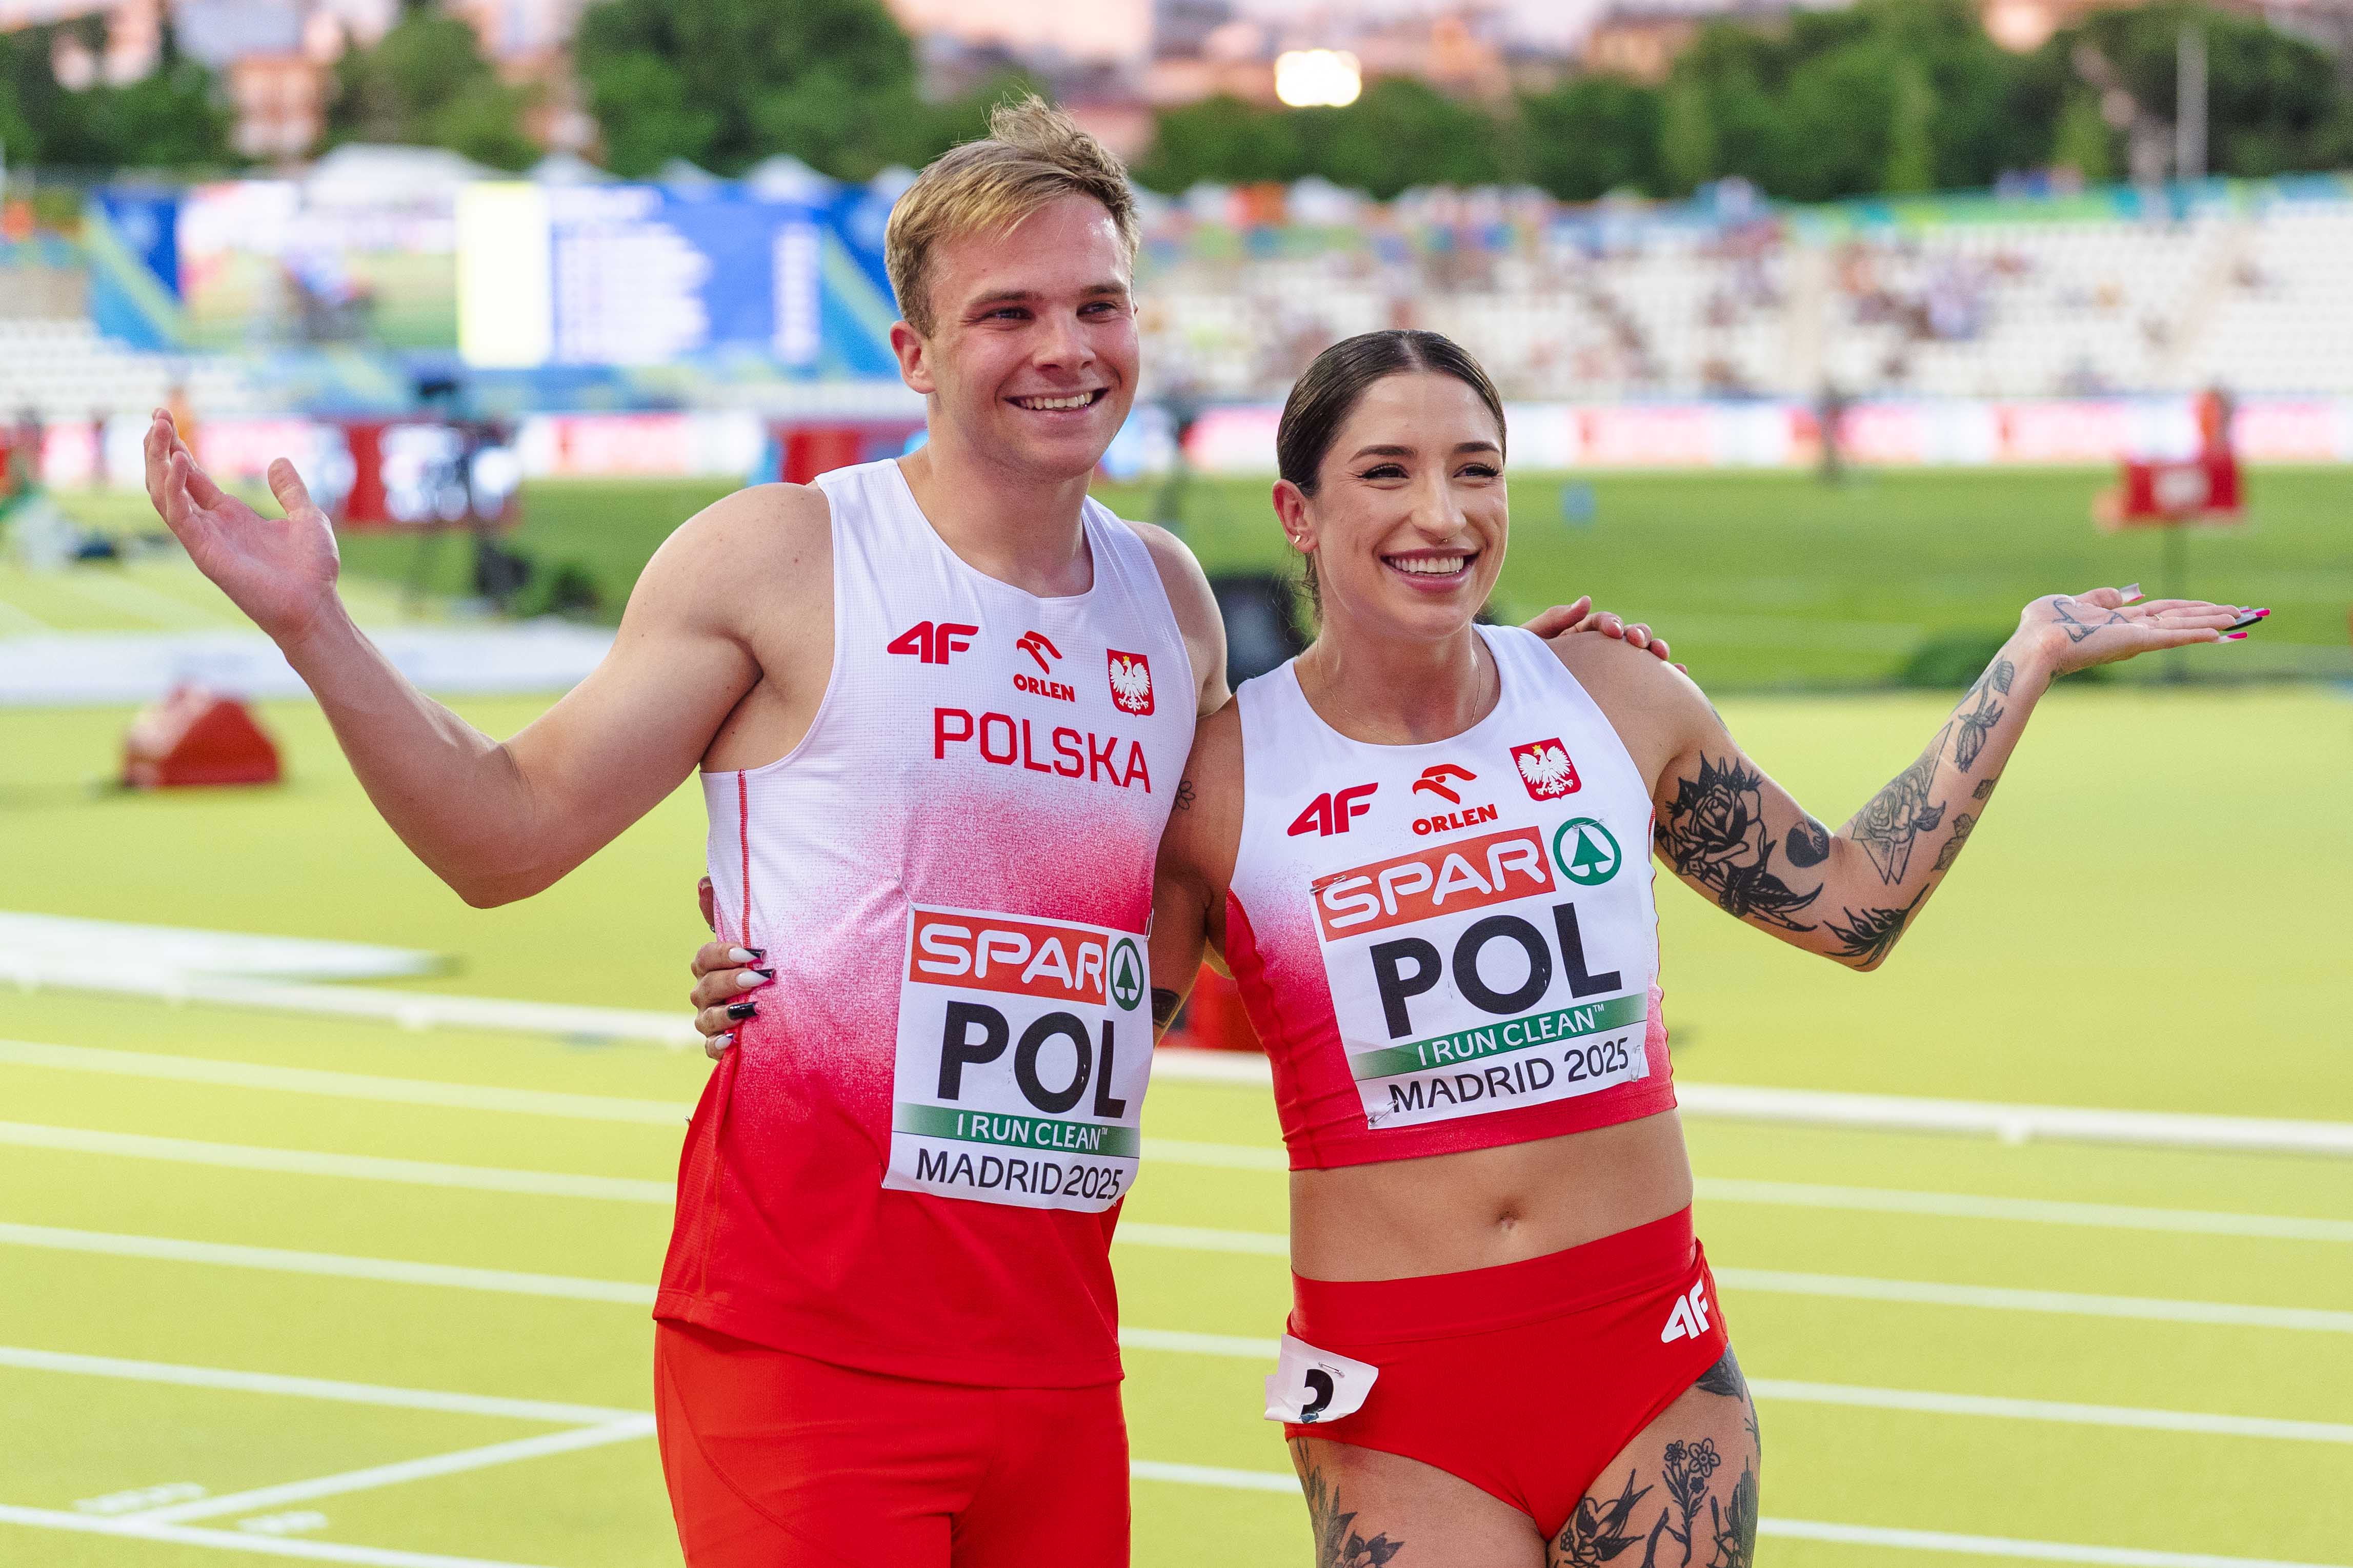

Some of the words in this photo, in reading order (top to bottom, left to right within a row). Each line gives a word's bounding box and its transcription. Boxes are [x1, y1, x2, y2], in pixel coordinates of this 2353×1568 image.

[887, 620, 979, 665] 4F
[1013, 673, 1075, 703] ORLEN
[934, 707, 1151, 794] POLSKA
[1286, 782, 1379, 837] 4F
[1412, 803, 1498, 836] ORLEN
[1322, 838, 1546, 928] SPAR
[918, 923, 1103, 994] SPAR
[1369, 902, 1622, 1040] POL
[937, 1000, 1127, 1119] POL
[1388, 1057, 1555, 1113] MADRID
[1563, 1036, 1629, 1083] 2025
[1418, 1044, 1427, 1066] I
[1431, 1029, 1496, 1064] RUN
[956, 1113, 964, 1135] I
[971, 1114, 1030, 1144] RUN
[915, 1148, 1062, 1195] MADRID
[1062, 1164, 1123, 1200] 2025
[1661, 1278, 1711, 1343] 4F
